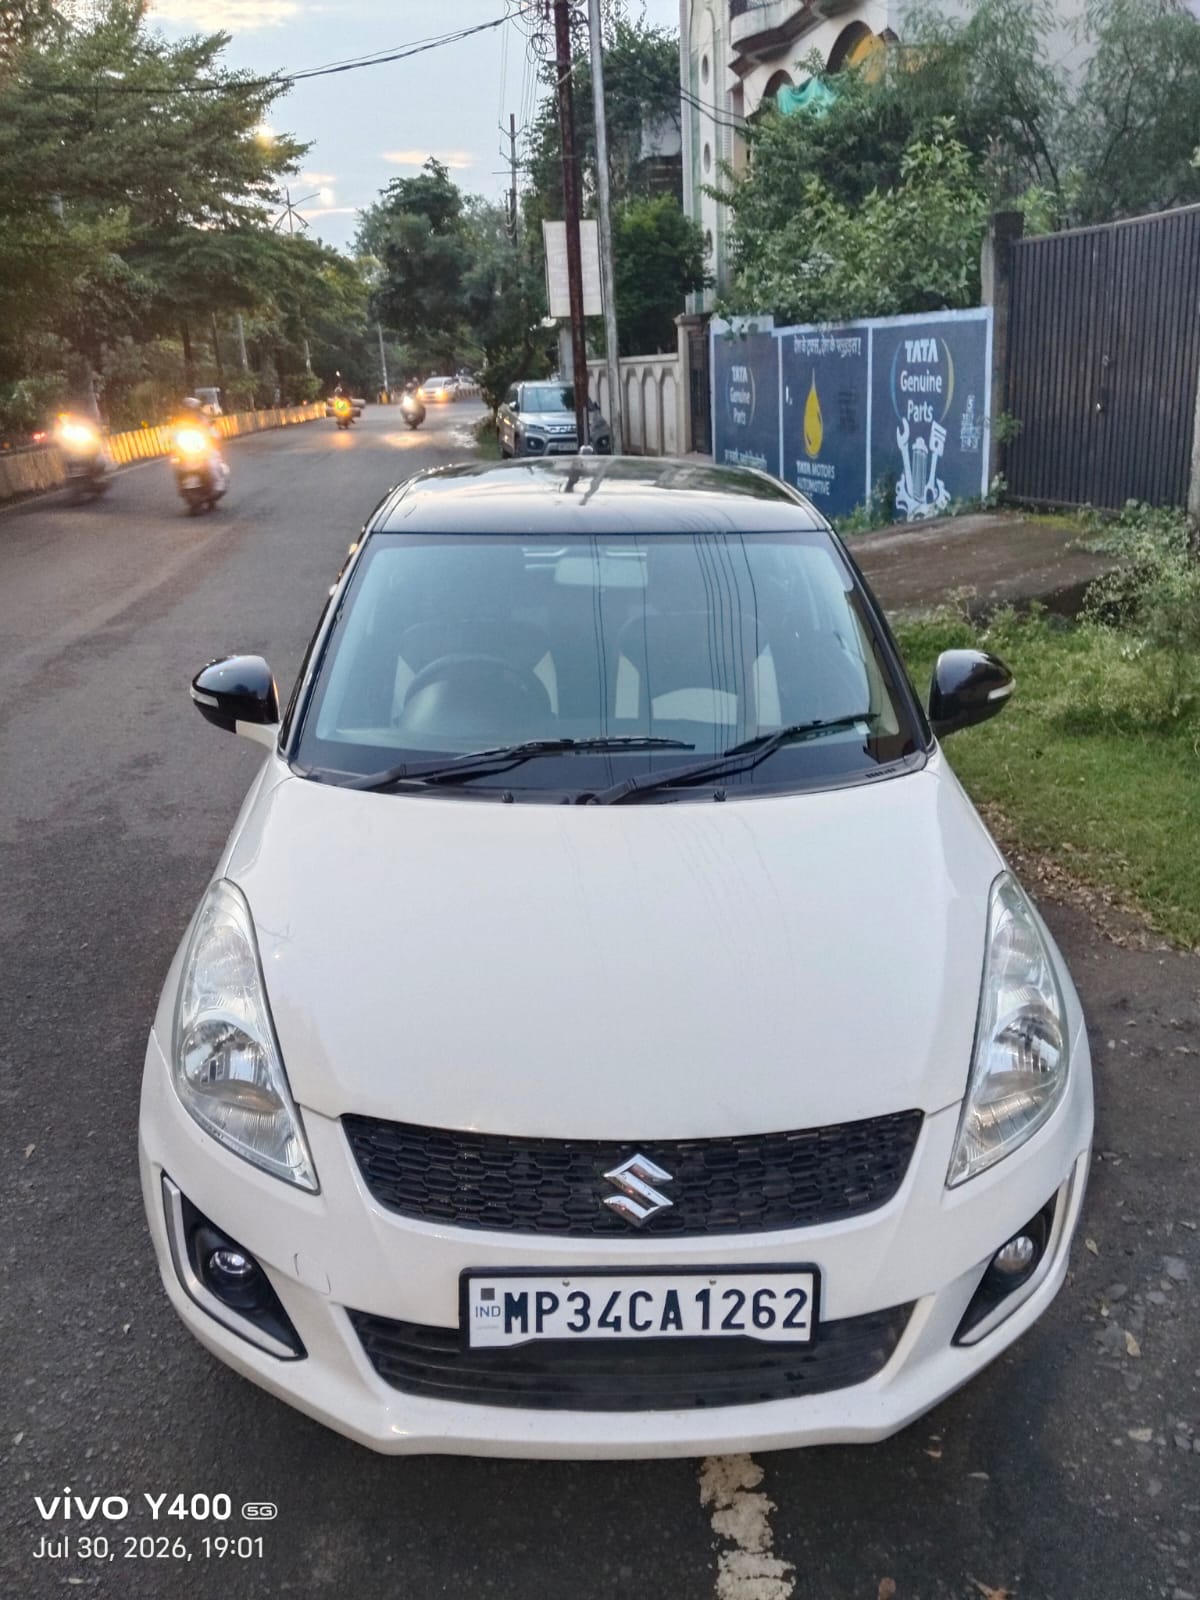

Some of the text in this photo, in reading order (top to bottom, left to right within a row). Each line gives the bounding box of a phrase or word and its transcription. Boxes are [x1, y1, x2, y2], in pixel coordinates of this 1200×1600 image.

[905, 338, 938, 363] TATA
[731, 365, 748, 382] TATA
[901, 369, 943, 393] Genuine
[907, 399, 934, 423] Parts
[796, 460, 835, 479] TATA MOTORS
[475, 1288, 809, 1334] IND MP34CA1262
